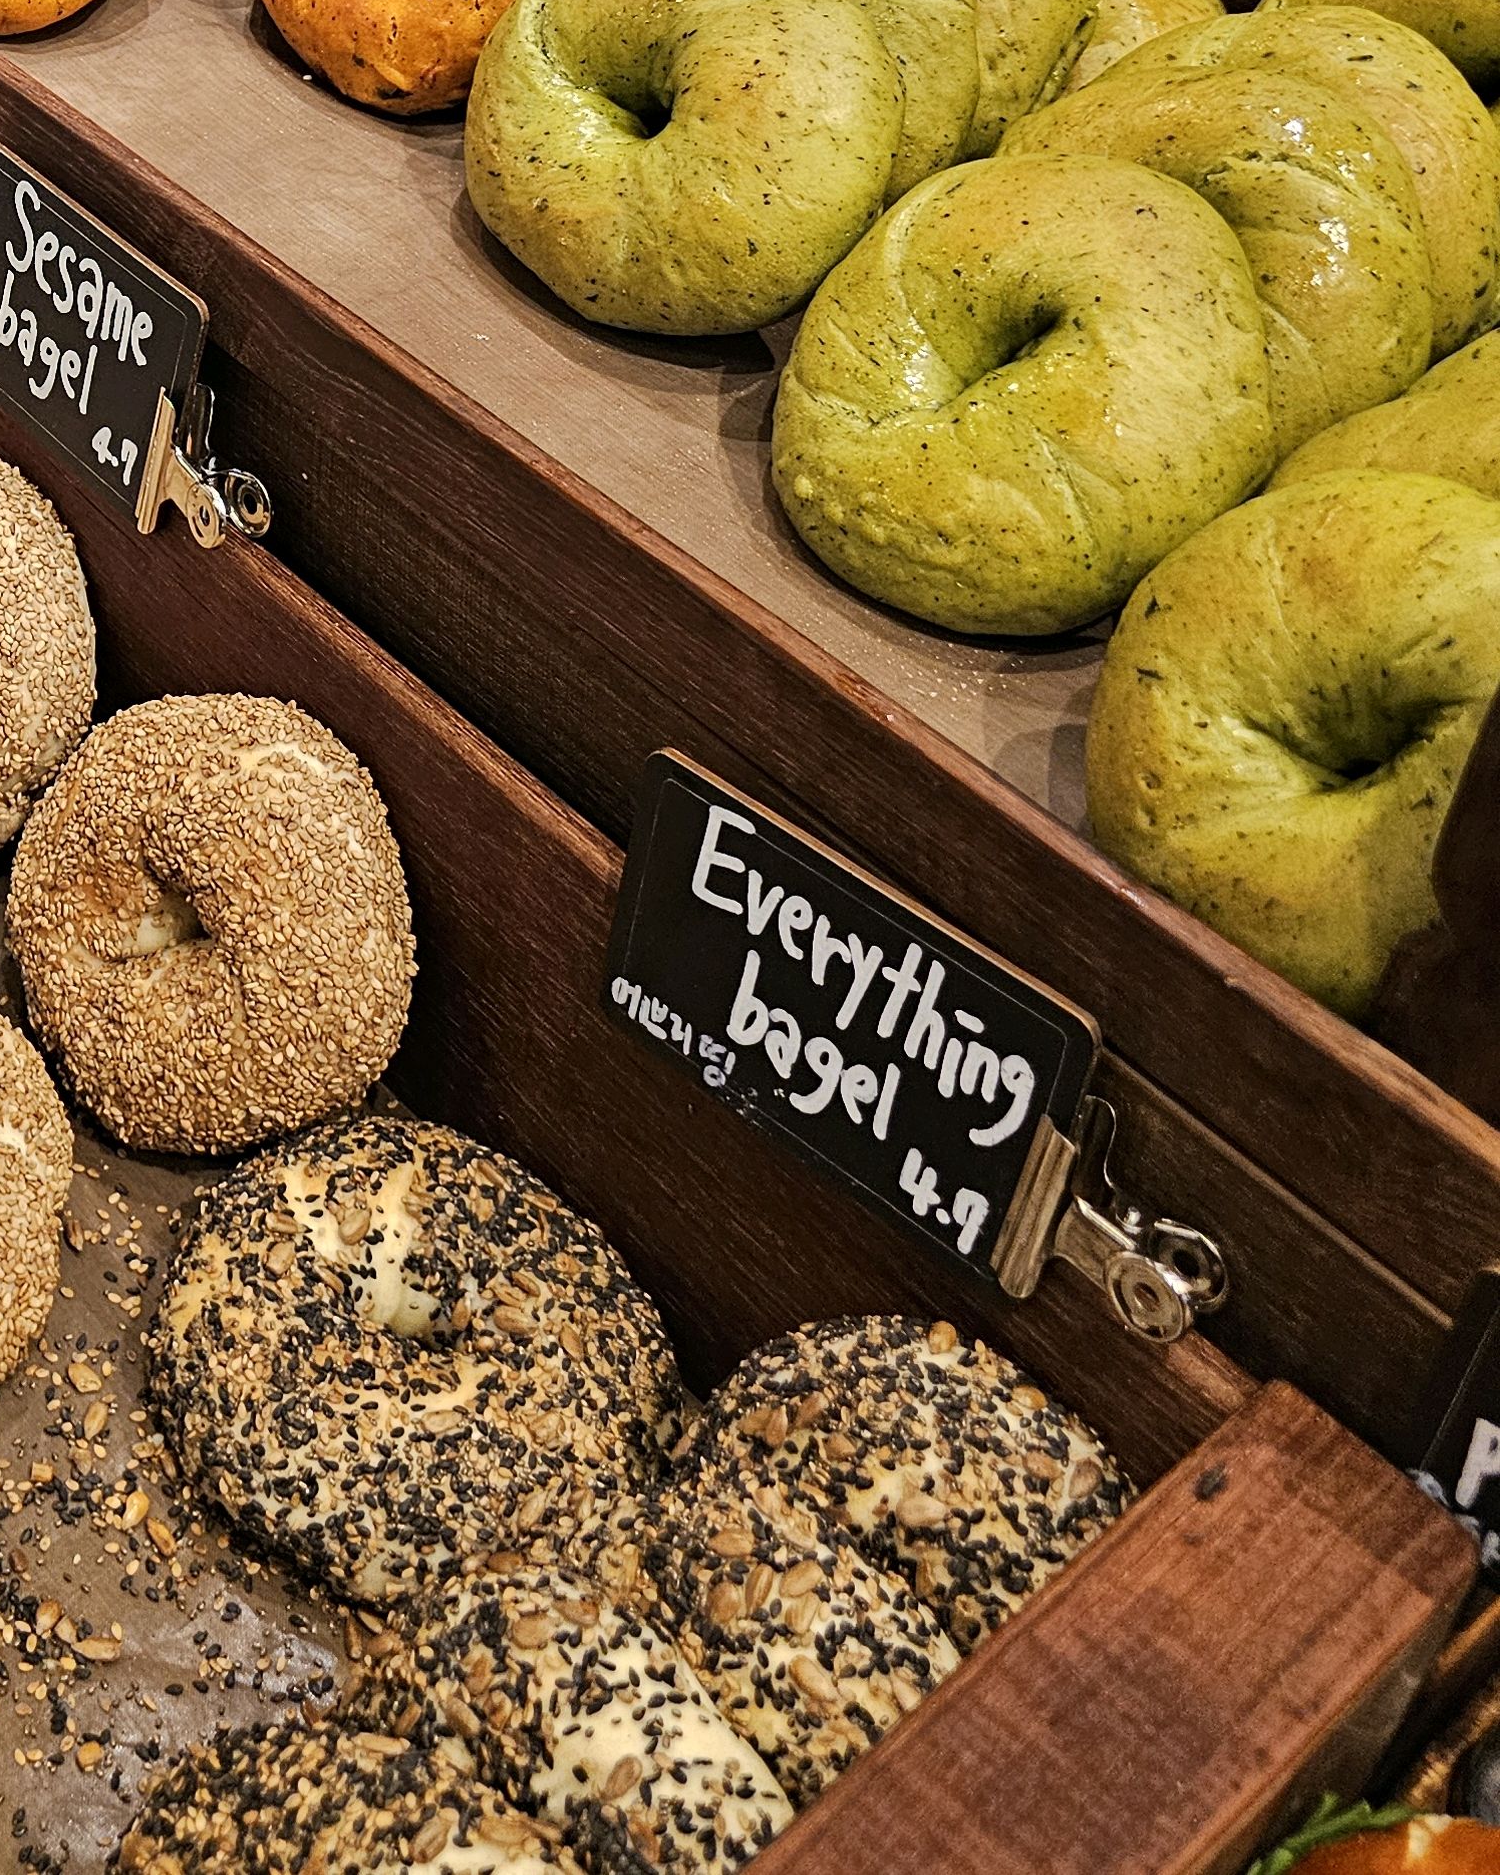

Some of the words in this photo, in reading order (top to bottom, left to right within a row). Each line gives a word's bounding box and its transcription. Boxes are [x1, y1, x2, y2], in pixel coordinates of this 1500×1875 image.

[5, 180, 153, 367] Sesame
[611, 976, 693, 1056] 에브리
[691, 804, 1036, 1148] Everything
[725, 949, 901, 1142] bagel
[899, 1147, 990, 1255] 4.7
